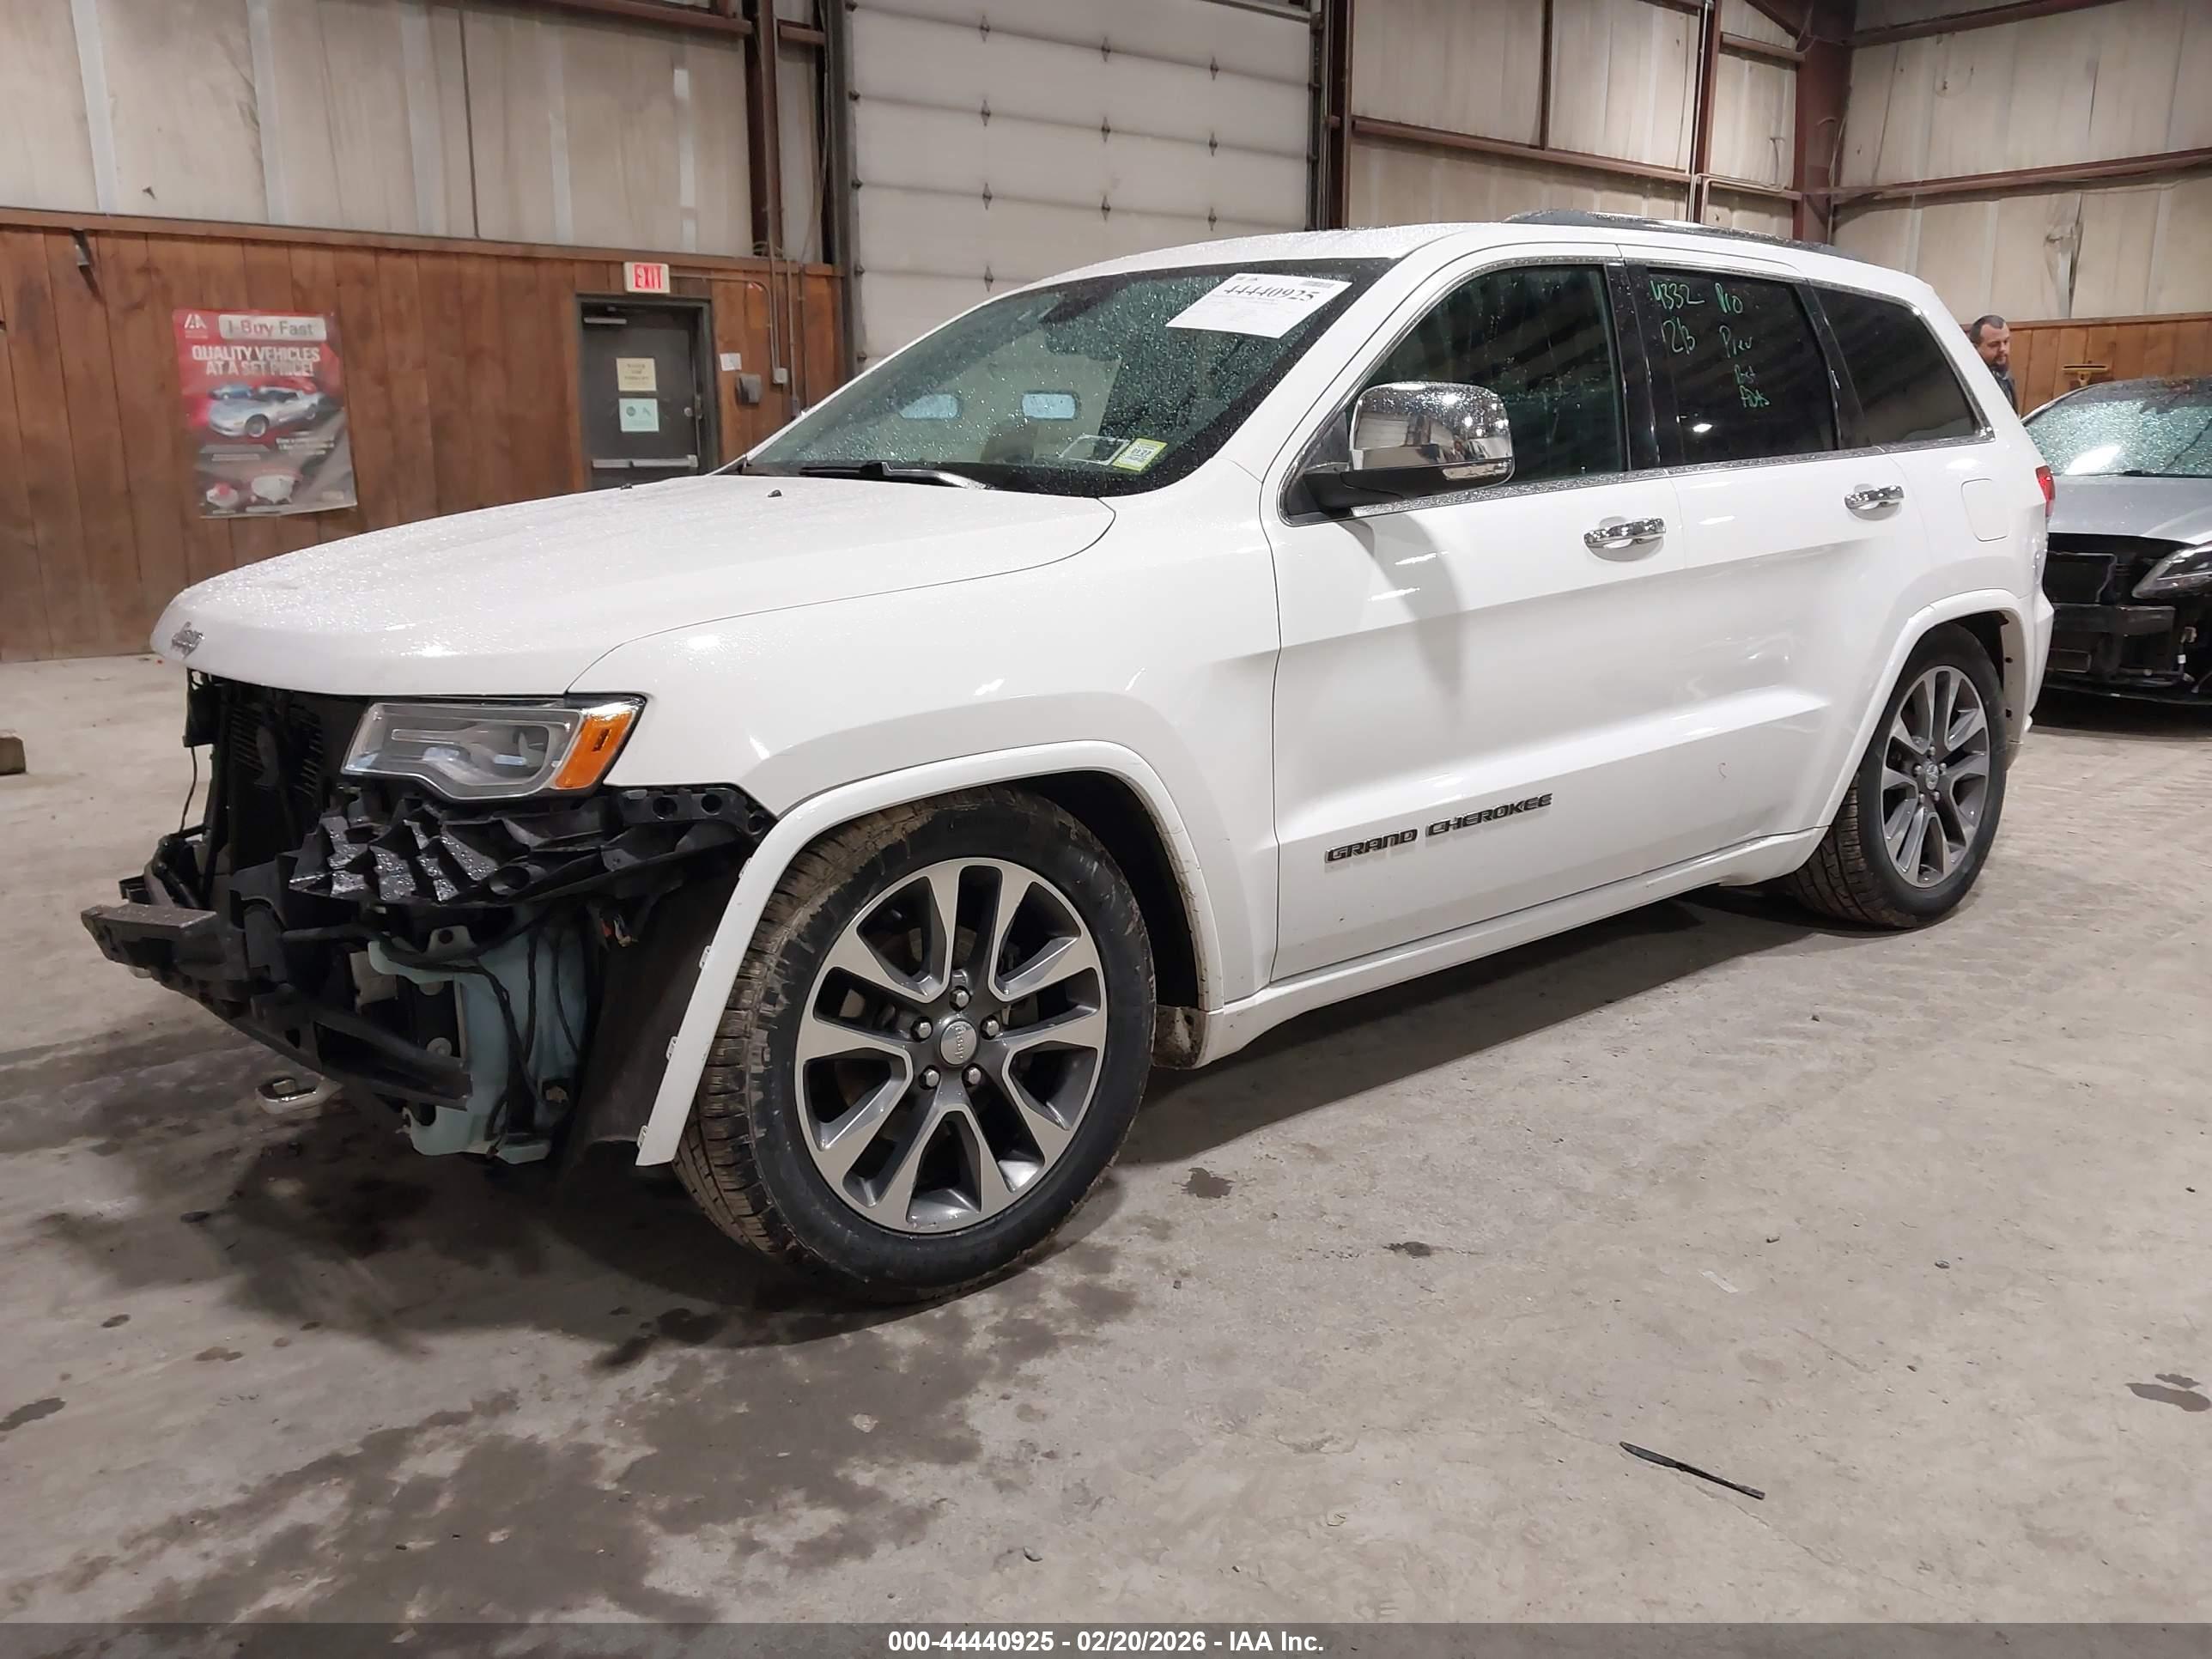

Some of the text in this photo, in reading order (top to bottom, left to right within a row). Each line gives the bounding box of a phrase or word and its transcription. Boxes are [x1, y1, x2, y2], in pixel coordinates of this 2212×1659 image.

[635, 264, 661, 289] EXIT
[279, 320, 313, 336] Fast
[191, 345, 321, 362] QUALITY VEHICLES
[206, 361, 226, 375] AT
[228, 361, 240, 375] A
[1325, 793, 1553, 863] GRAND CHEROKEE
